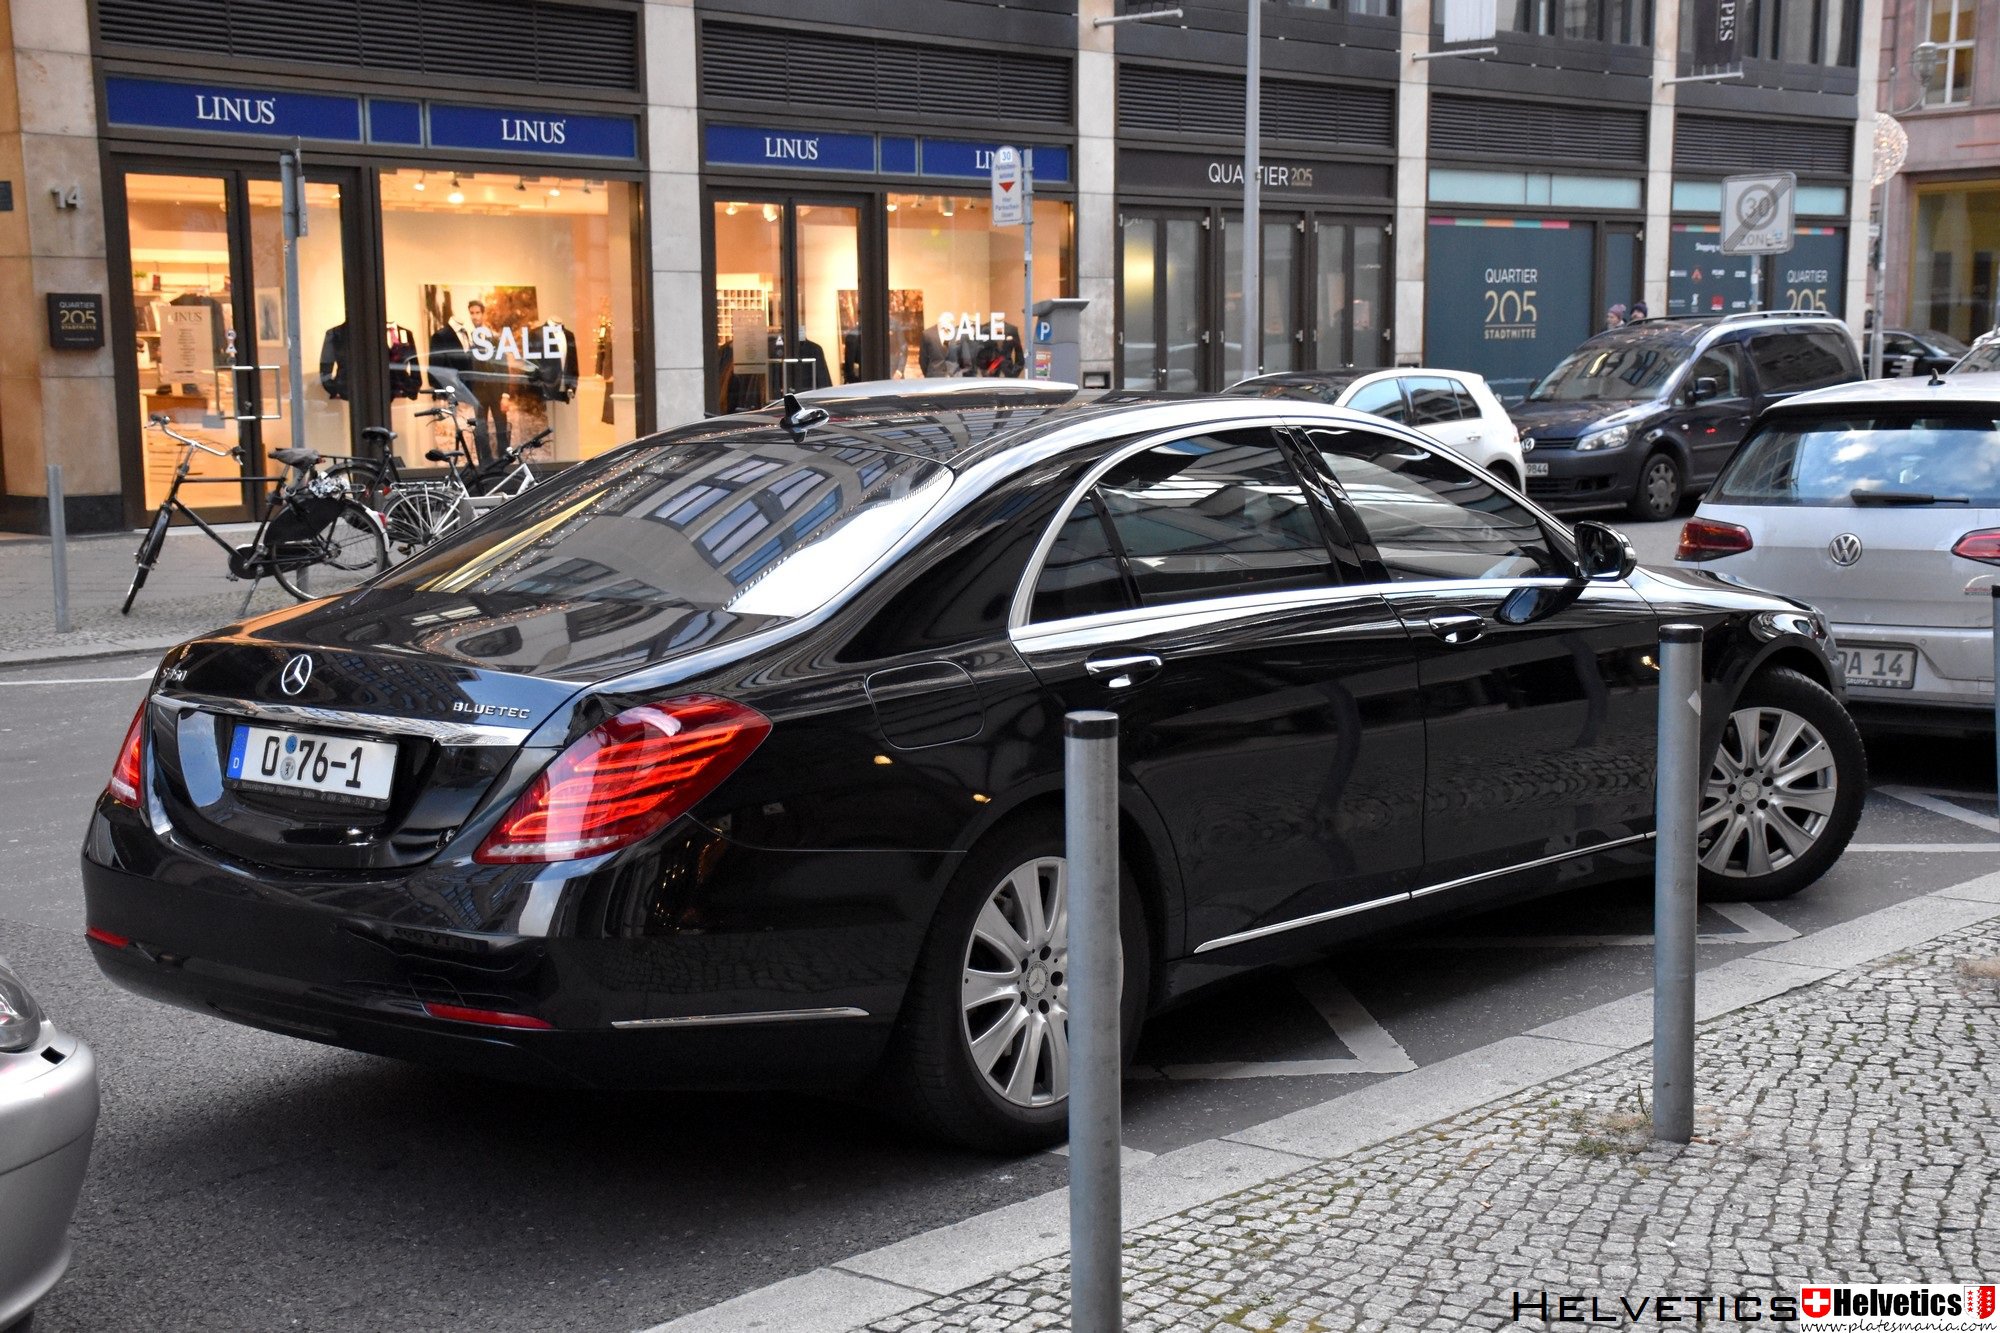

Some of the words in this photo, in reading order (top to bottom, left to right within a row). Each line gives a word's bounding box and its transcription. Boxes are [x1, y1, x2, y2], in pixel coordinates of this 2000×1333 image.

[1720, 2, 1735, 41] PES
[1208, 163, 1289, 186] QUAIER
[53, 184, 82, 209] 14
[1745, 197, 1771, 217] 30
[1485, 268, 1538, 283] QUARTIER
[1787, 270, 1828, 283] QUARTIER
[1485, 290, 1537, 322] 205
[1787, 289, 1827, 311] 205
[60, 310, 97, 323] 205
[472, 326, 563, 361] SALE
[1484, 329, 1537, 339] STADTMITTE
[1872, 653, 1903, 677] 14
[453, 701, 531, 719] BLUETEC
[297, 740, 363, 789] 76-1
